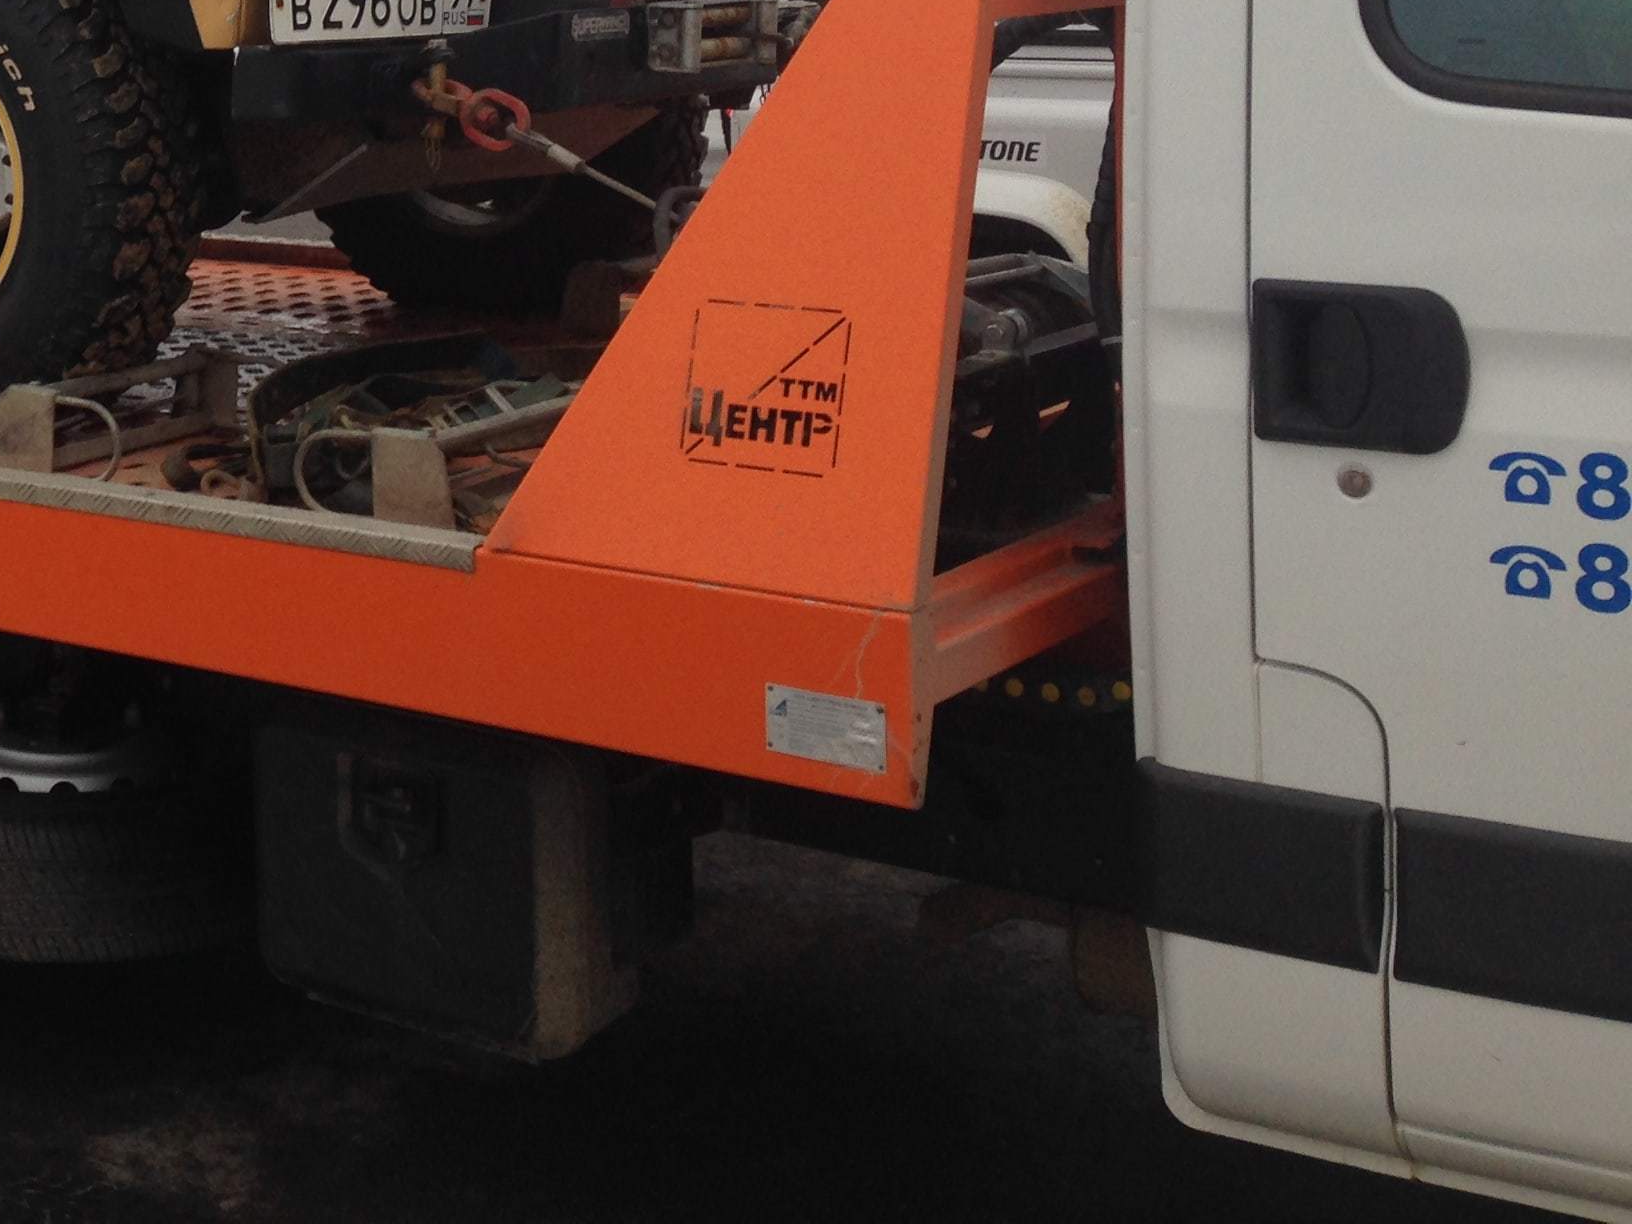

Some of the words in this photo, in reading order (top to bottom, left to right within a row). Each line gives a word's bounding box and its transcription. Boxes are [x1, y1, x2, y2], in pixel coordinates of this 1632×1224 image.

[442, 10, 466, 25] RUS
[688, 386, 834, 448] ЦЕНТР
[1575, 451, 1632, 521] 8
[1575, 542, 1632, 614] 8
